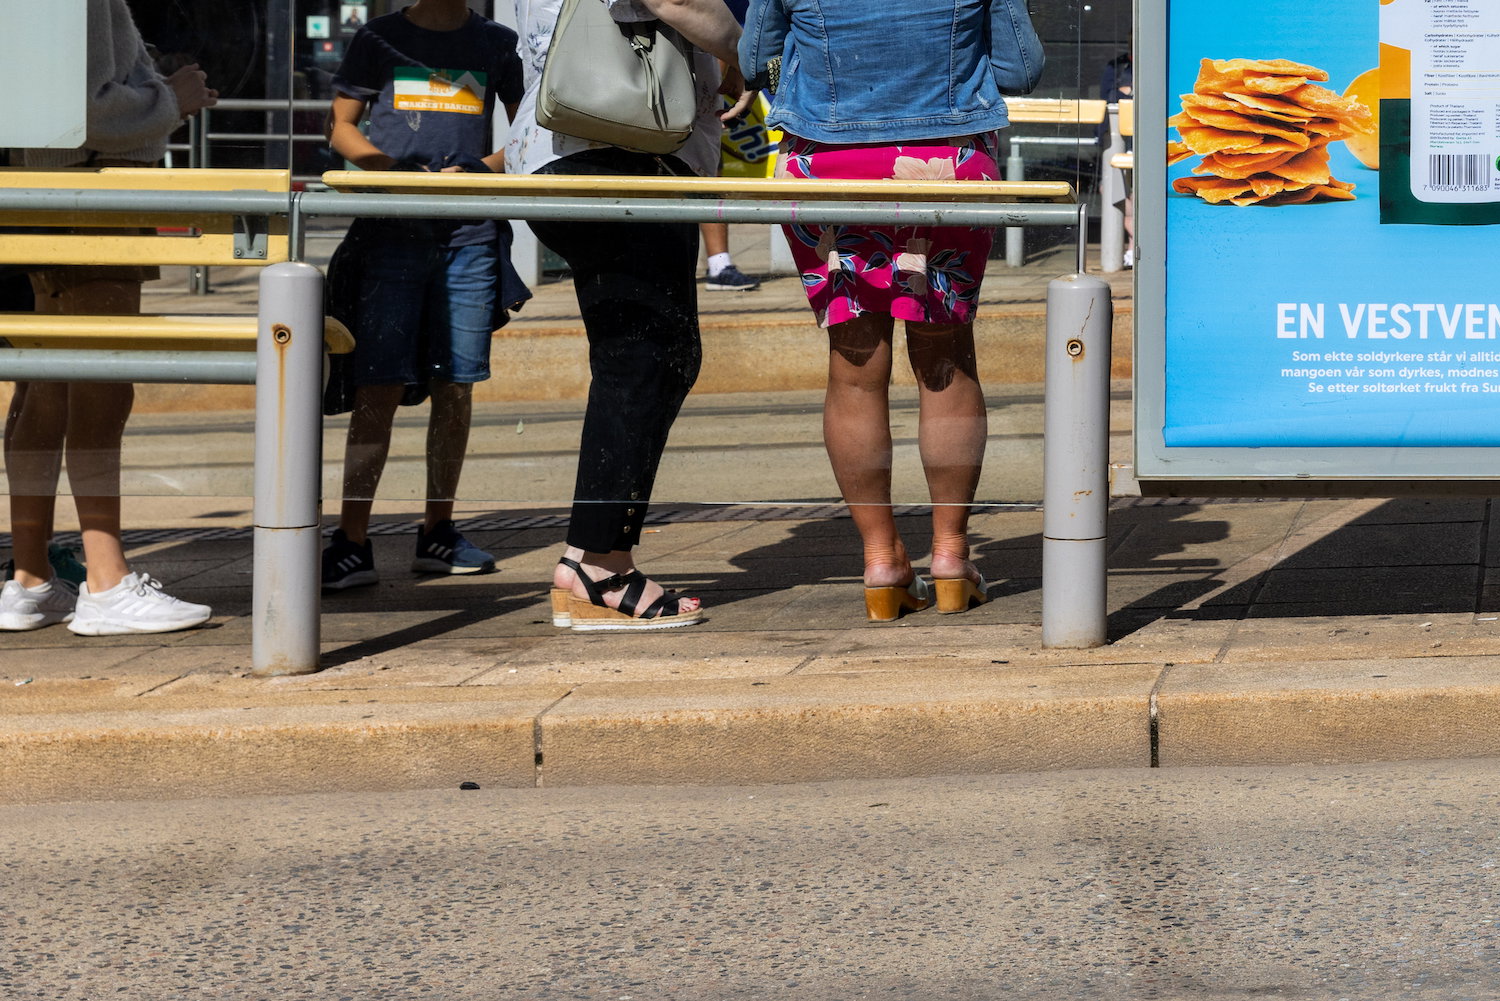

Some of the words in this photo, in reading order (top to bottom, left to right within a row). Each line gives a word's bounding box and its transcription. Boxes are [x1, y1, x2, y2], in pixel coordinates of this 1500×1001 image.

[1276, 302, 1326, 339] EN
[1292, 351, 1321, 362] Som
[1324, 351, 1354, 362] ekte
[1357, 351, 1425, 364] soldyrkere
[1427, 350, 1453, 362] står
[1455, 351, 1467, 362] vi
[1281, 369, 1342, 380] mangoen
[1344, 366, 1366, 378] vår
[1368, 369, 1396, 378] som
[1398, 367, 1445, 380] dyrkes,
[1447, 367, 1499, 379] modnes
[1308, 383, 1325, 393] Se
[1327, 383, 1360, 393] etter
[1362, 382, 1422, 393] soltørket
[1424, 382, 1458, 393] frukt
[1460, 382, 1479, 393] fra
